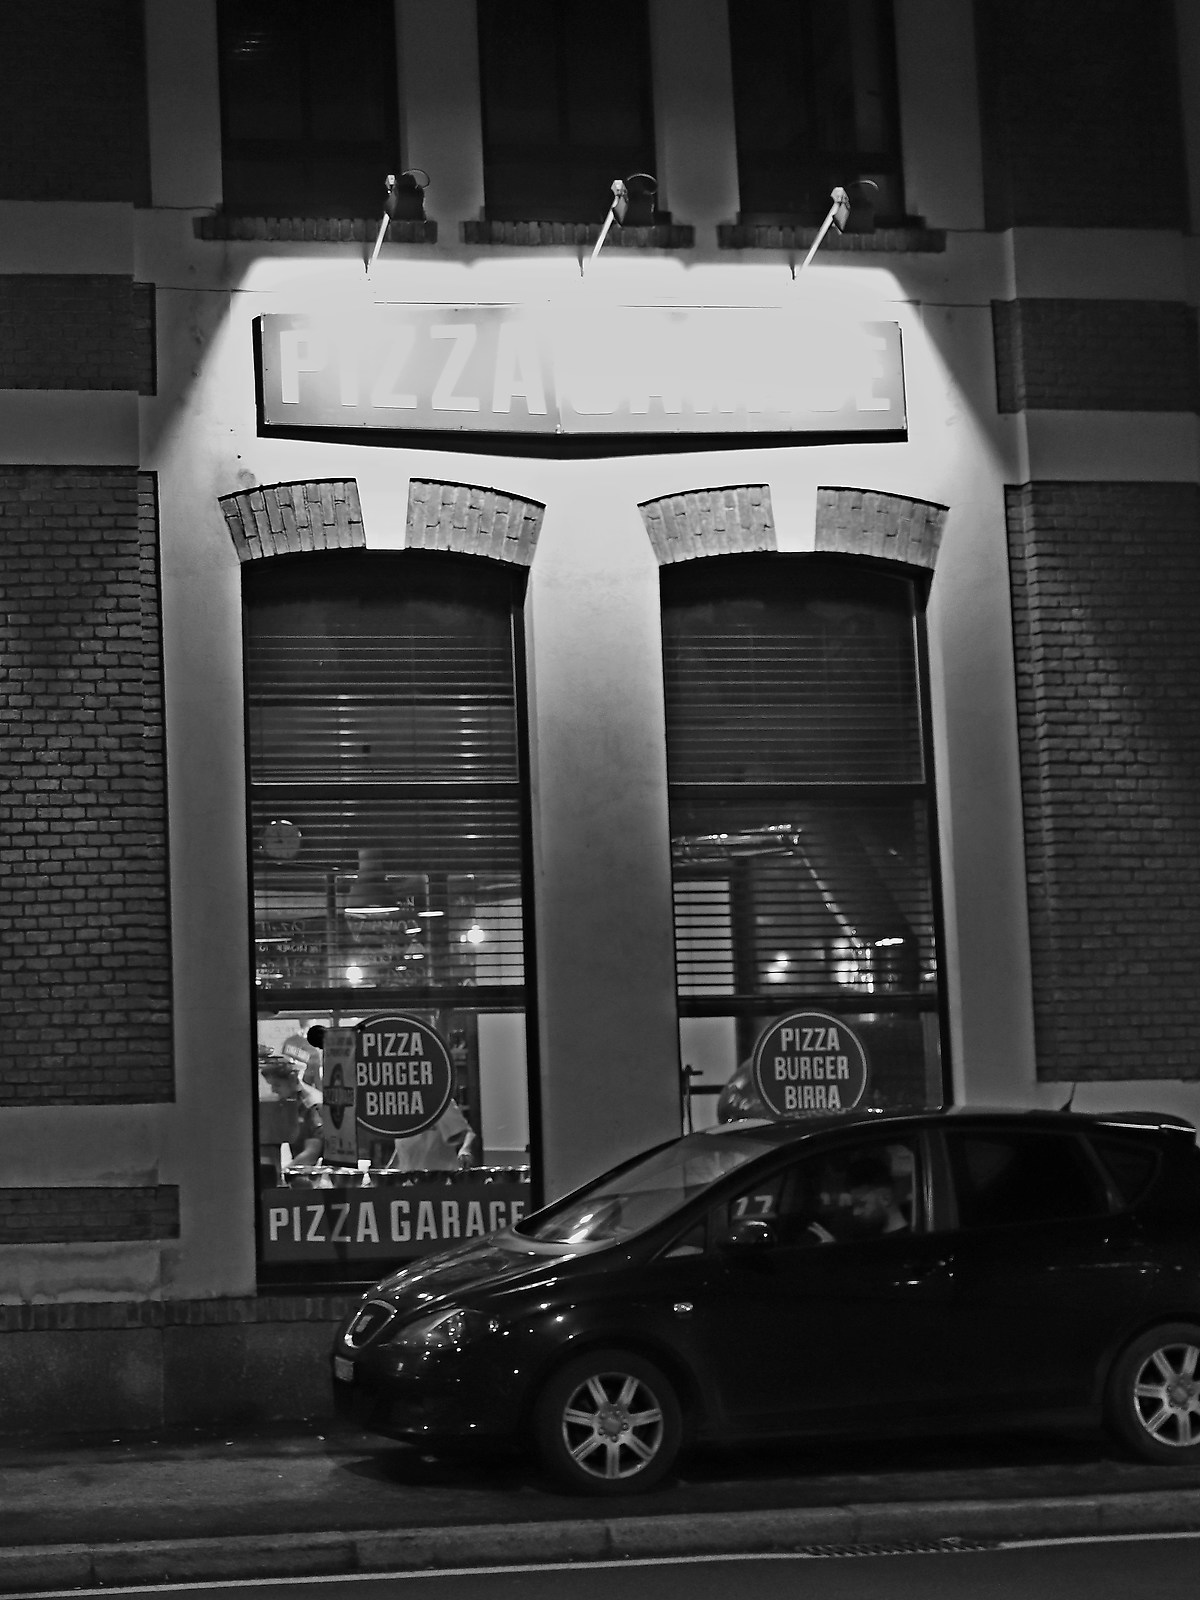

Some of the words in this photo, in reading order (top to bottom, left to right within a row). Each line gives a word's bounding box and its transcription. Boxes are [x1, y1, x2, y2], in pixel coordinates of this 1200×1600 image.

[280, 322, 547, 415] PIZZA
[362, 1032, 424, 1057] PIZZA
[780, 1027, 840, 1051] PIZZA
[357, 1061, 433, 1086] BURGER
[774, 1055, 850, 1081] BURGER
[366, 1091, 424, 1116] BIRRA
[785, 1084, 841, 1110] BIRRA
[269, 1201, 380, 1243] PIZZA
